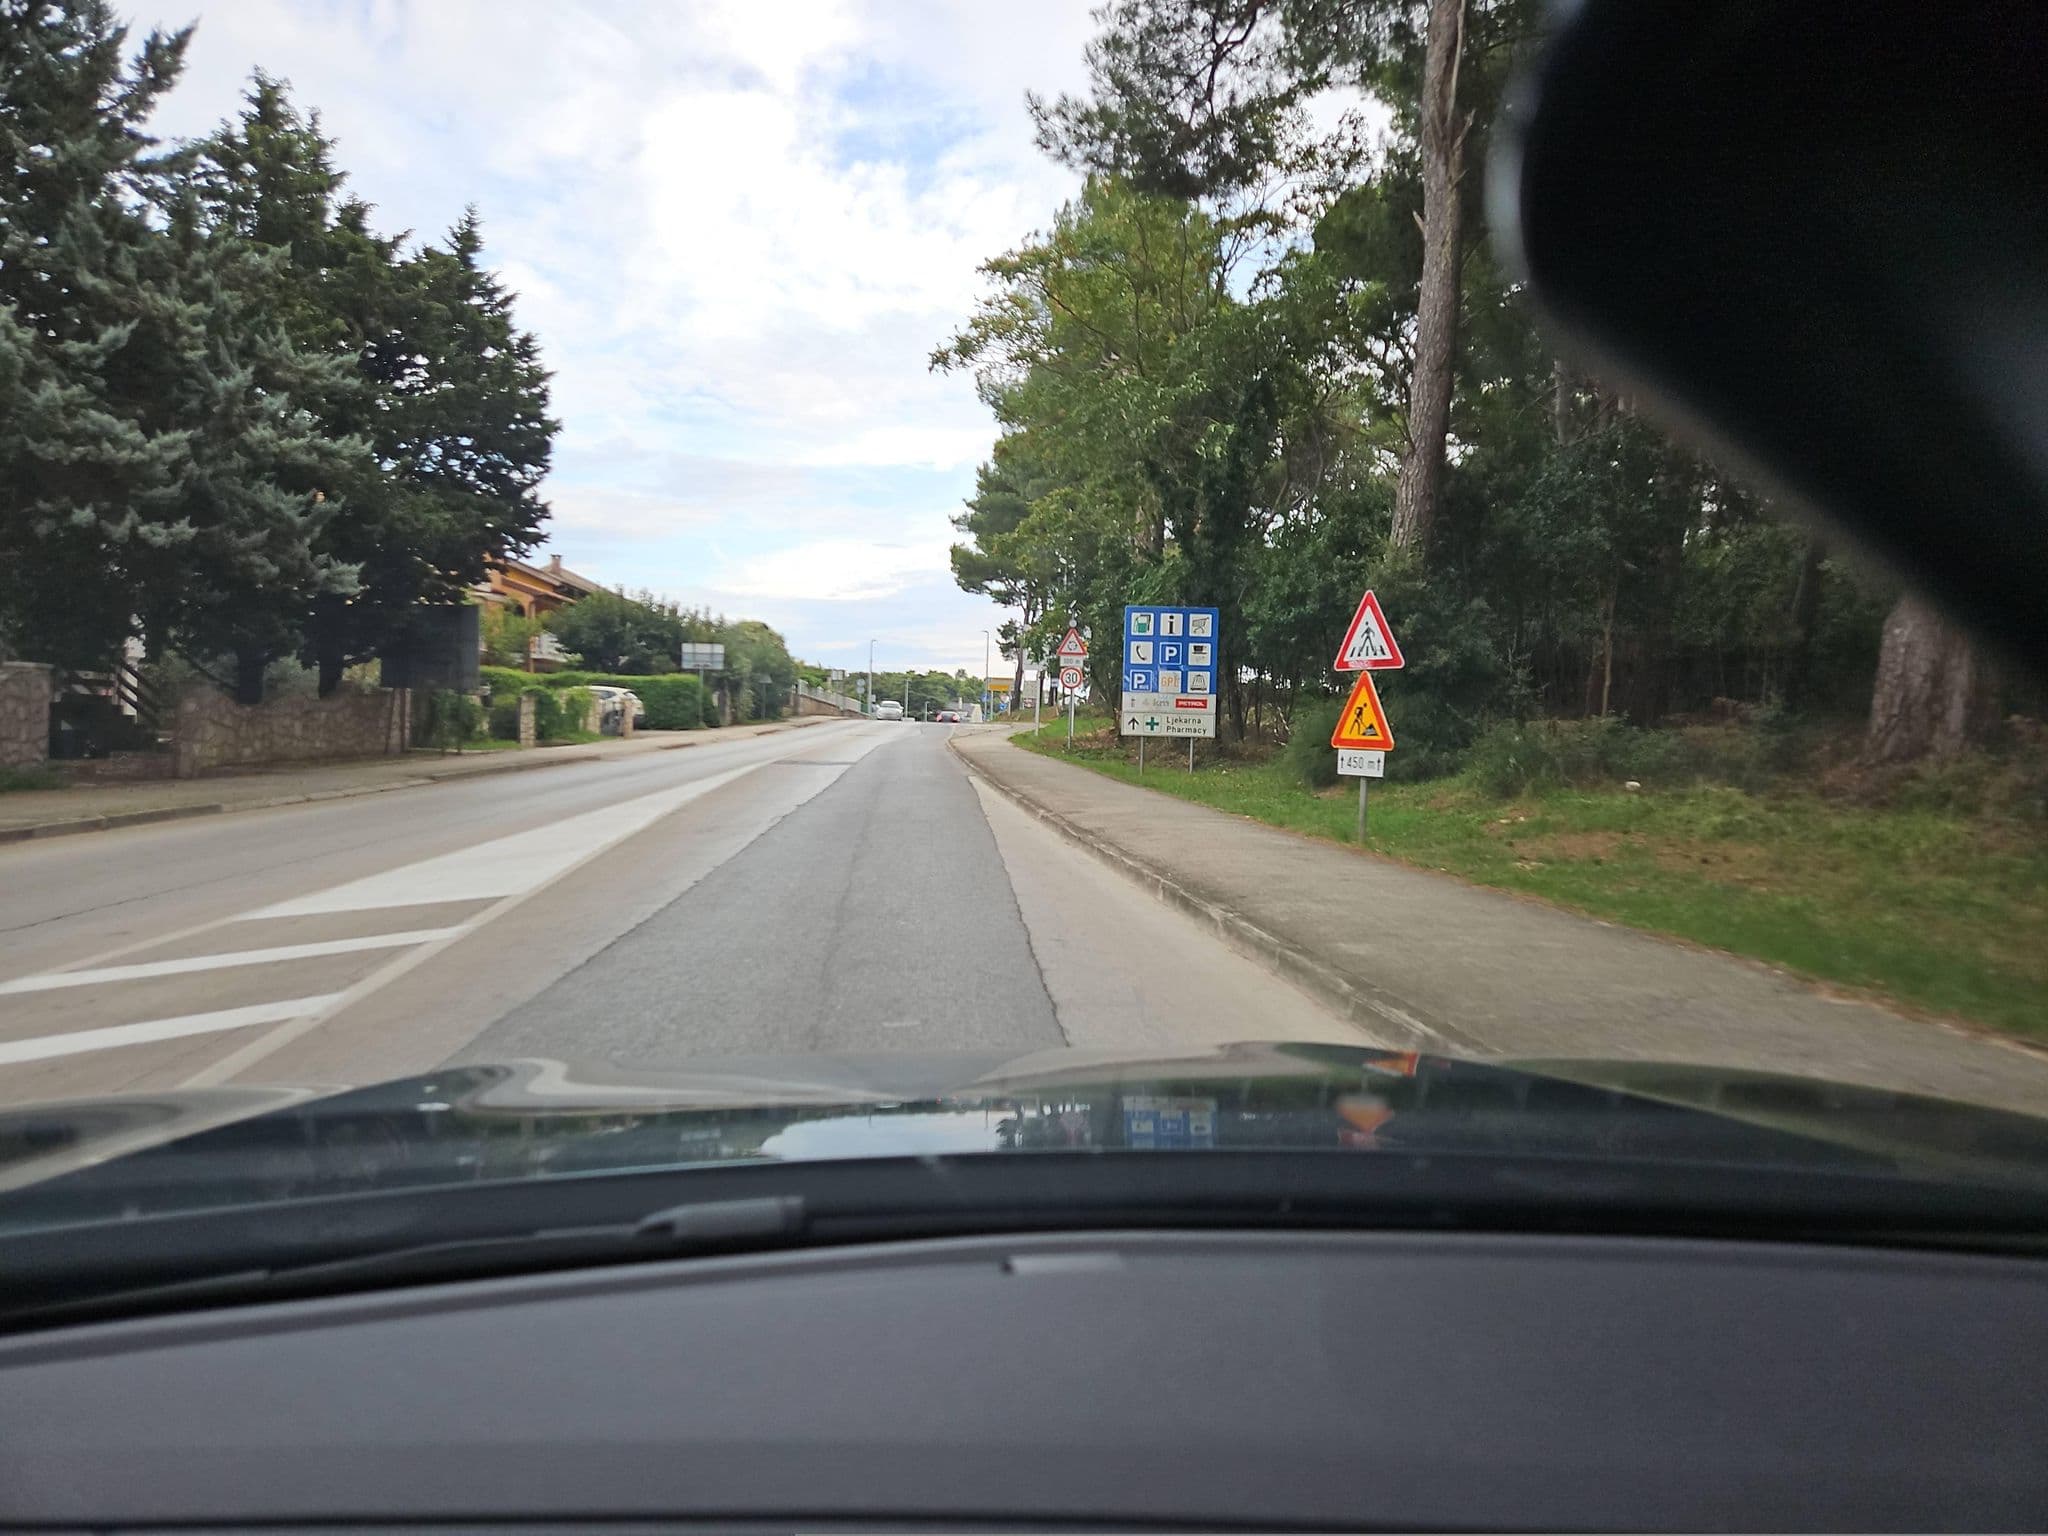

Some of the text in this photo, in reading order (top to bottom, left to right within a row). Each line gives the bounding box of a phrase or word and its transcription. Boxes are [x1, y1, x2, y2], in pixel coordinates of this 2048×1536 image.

[1165, 646, 1178, 662] P
[1065, 672, 1078, 684] 30
[1133, 673, 1146, 689] P
[1152, 698, 1170, 707] km
[1166, 716, 1202, 725] Ljekarna
[1166, 725, 1207, 735] Pharmacy
[1347, 757, 1376, 769] 450 m
